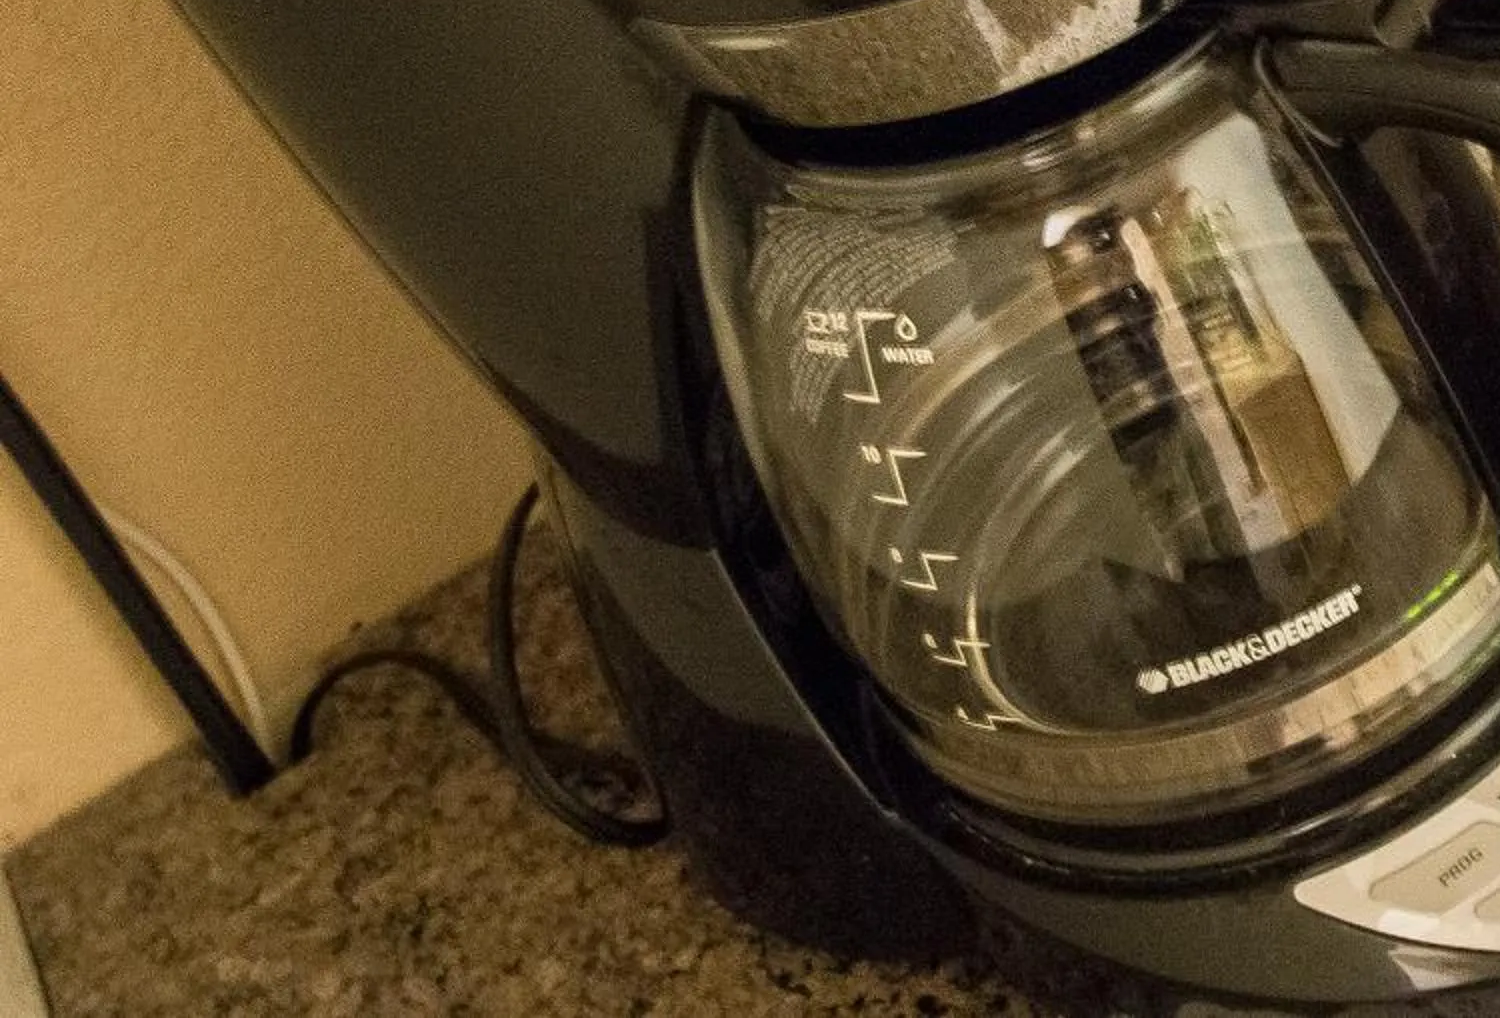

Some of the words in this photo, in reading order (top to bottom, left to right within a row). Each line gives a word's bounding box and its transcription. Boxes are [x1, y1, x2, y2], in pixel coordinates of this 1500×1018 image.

[881, 346, 936, 365] WATER
[861, 444, 882, 464] 10
[1437, 846, 1484, 887] PROG
